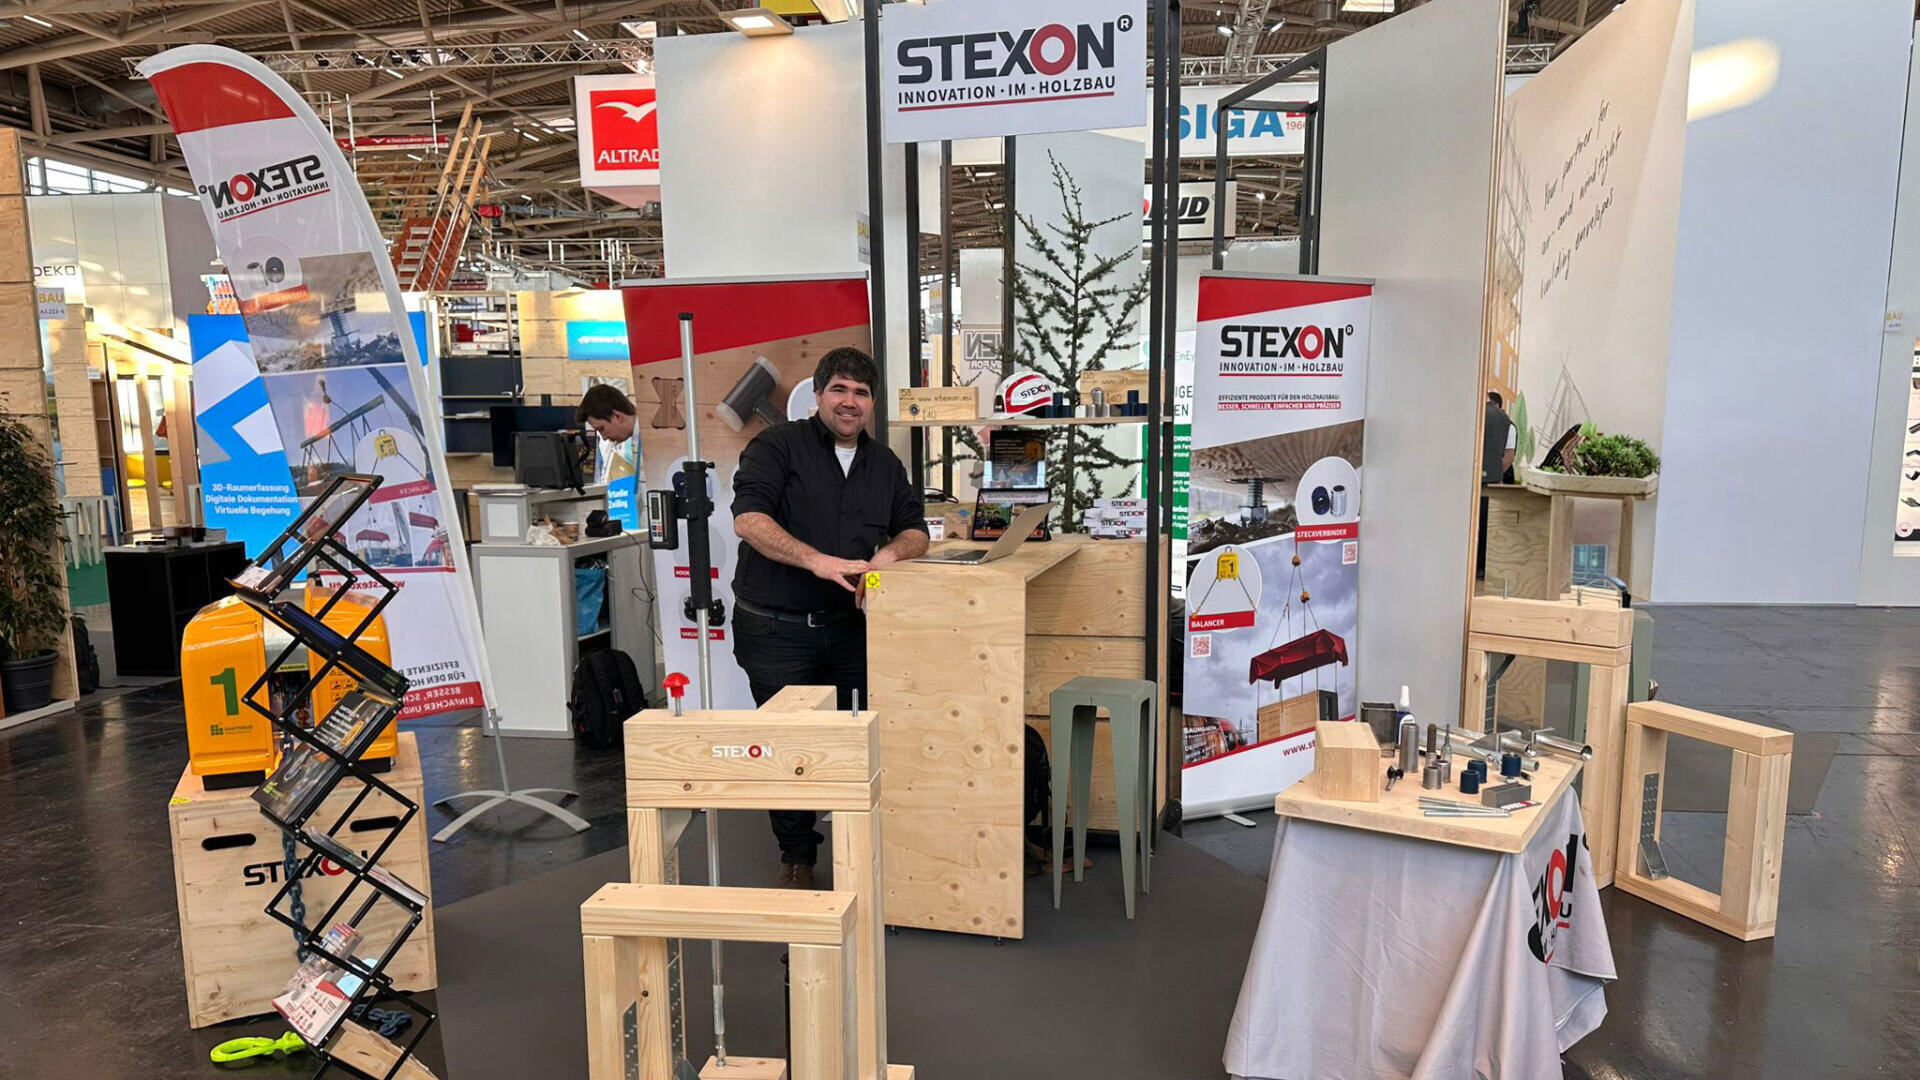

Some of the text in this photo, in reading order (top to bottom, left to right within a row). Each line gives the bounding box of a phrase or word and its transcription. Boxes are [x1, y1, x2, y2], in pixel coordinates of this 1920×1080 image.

[898, 75, 1116, 104] INNOVATION IM HOLZBAU
[39, 292, 64, 304] BAU
[1219, 362, 1344, 372] INNOVATION IM HOLZBAU
[1020, 384, 1051, 399] STEXON
[212, 483, 290, 494] 3D-Raumerfassung
[205, 494, 299, 505] Digitale Dokumentation
[214, 506, 291, 517] Virtuelle Begehung
[1296, 528, 1347, 539] STECKVERBINDER
[1191, 618, 1225, 629] BALANCER
[210, 667, 239, 716] 1
[711, 744, 773, 759] STEXON
